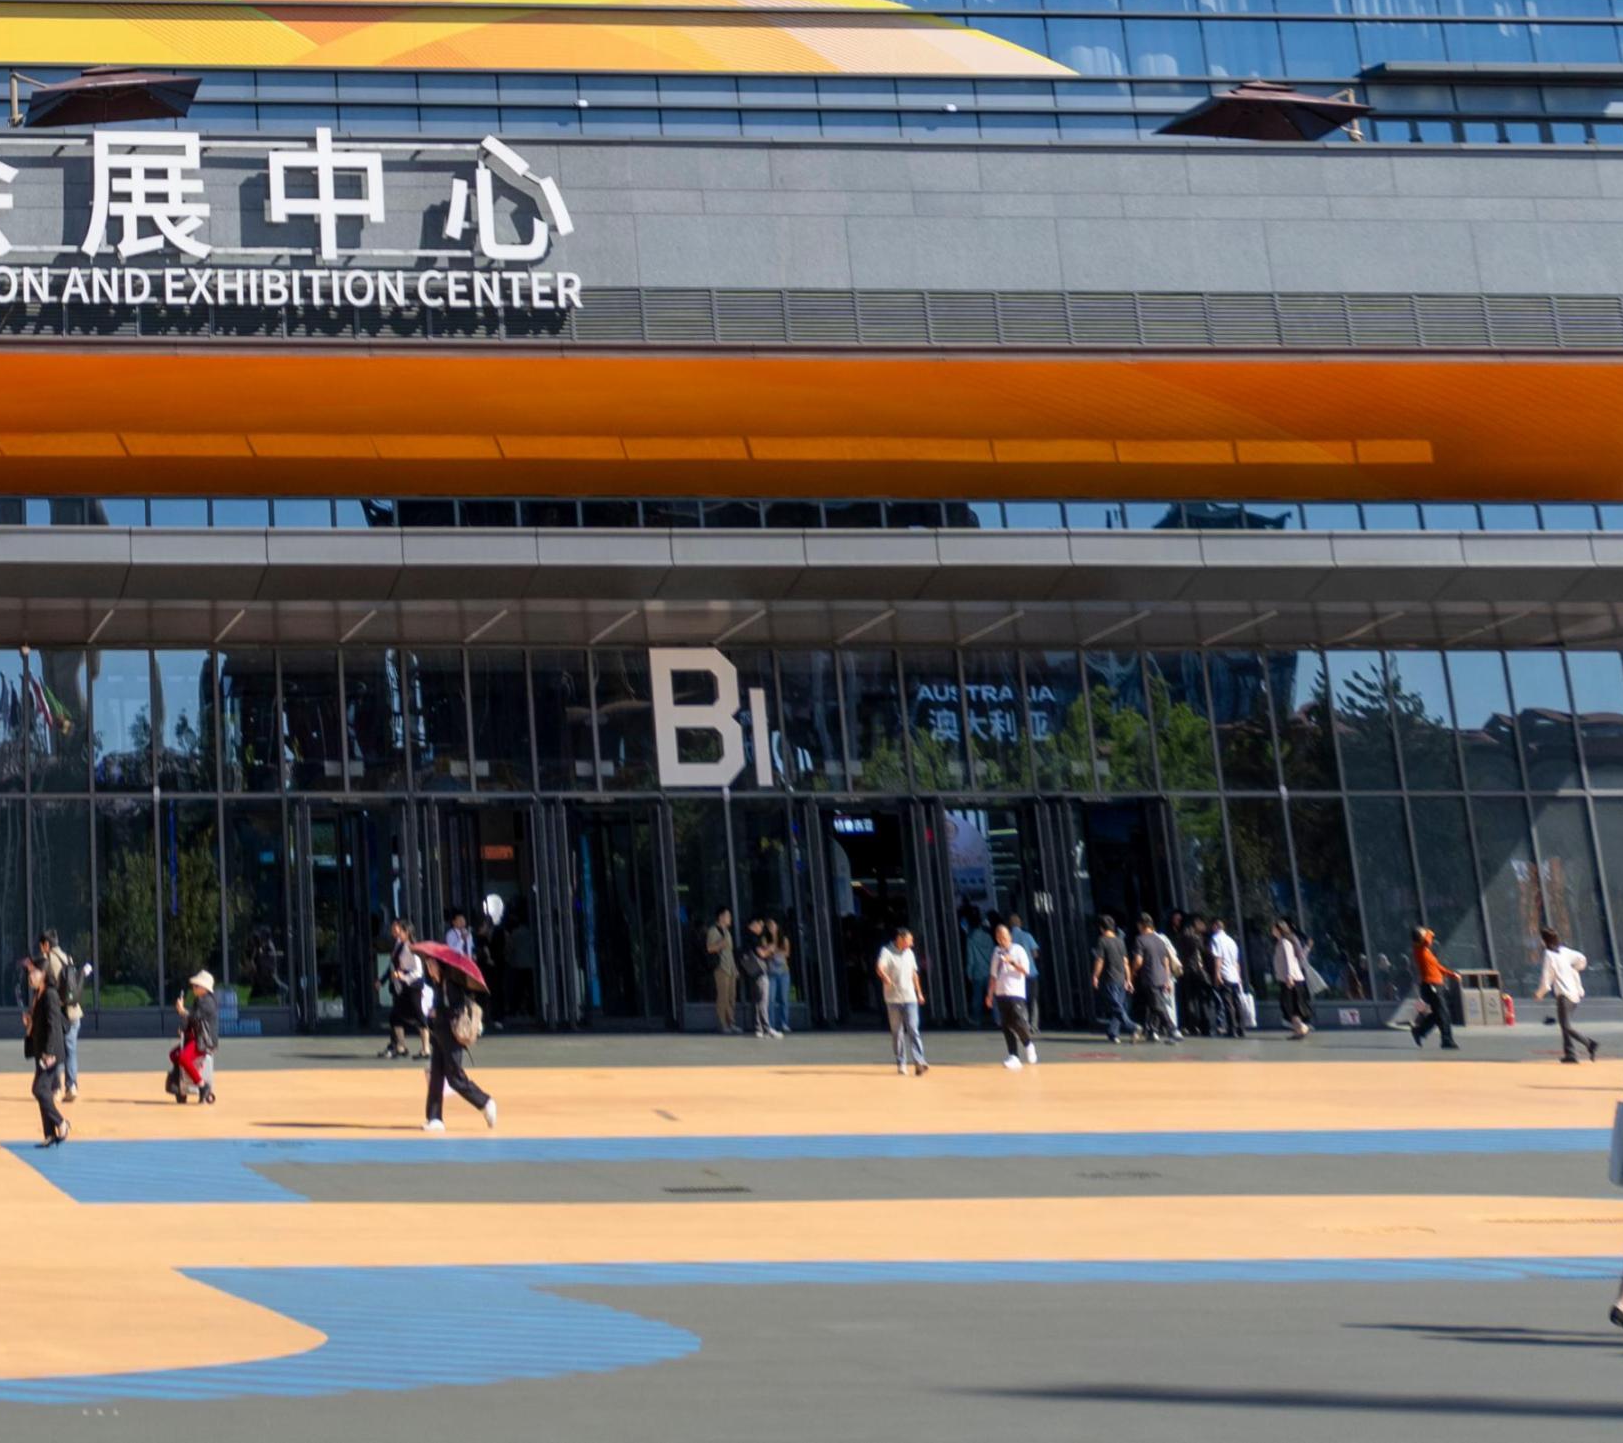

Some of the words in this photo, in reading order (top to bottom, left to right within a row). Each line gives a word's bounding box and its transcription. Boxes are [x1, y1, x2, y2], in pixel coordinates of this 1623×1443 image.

[61, 265, 152, 304] AND
[164, 267, 406, 306] EXHIBITION
[416, 269, 583, 309] CENTER
[917, 684, 1056, 702] AUSTRAIA
[929, 708, 1051, 743] 澳大利亚
